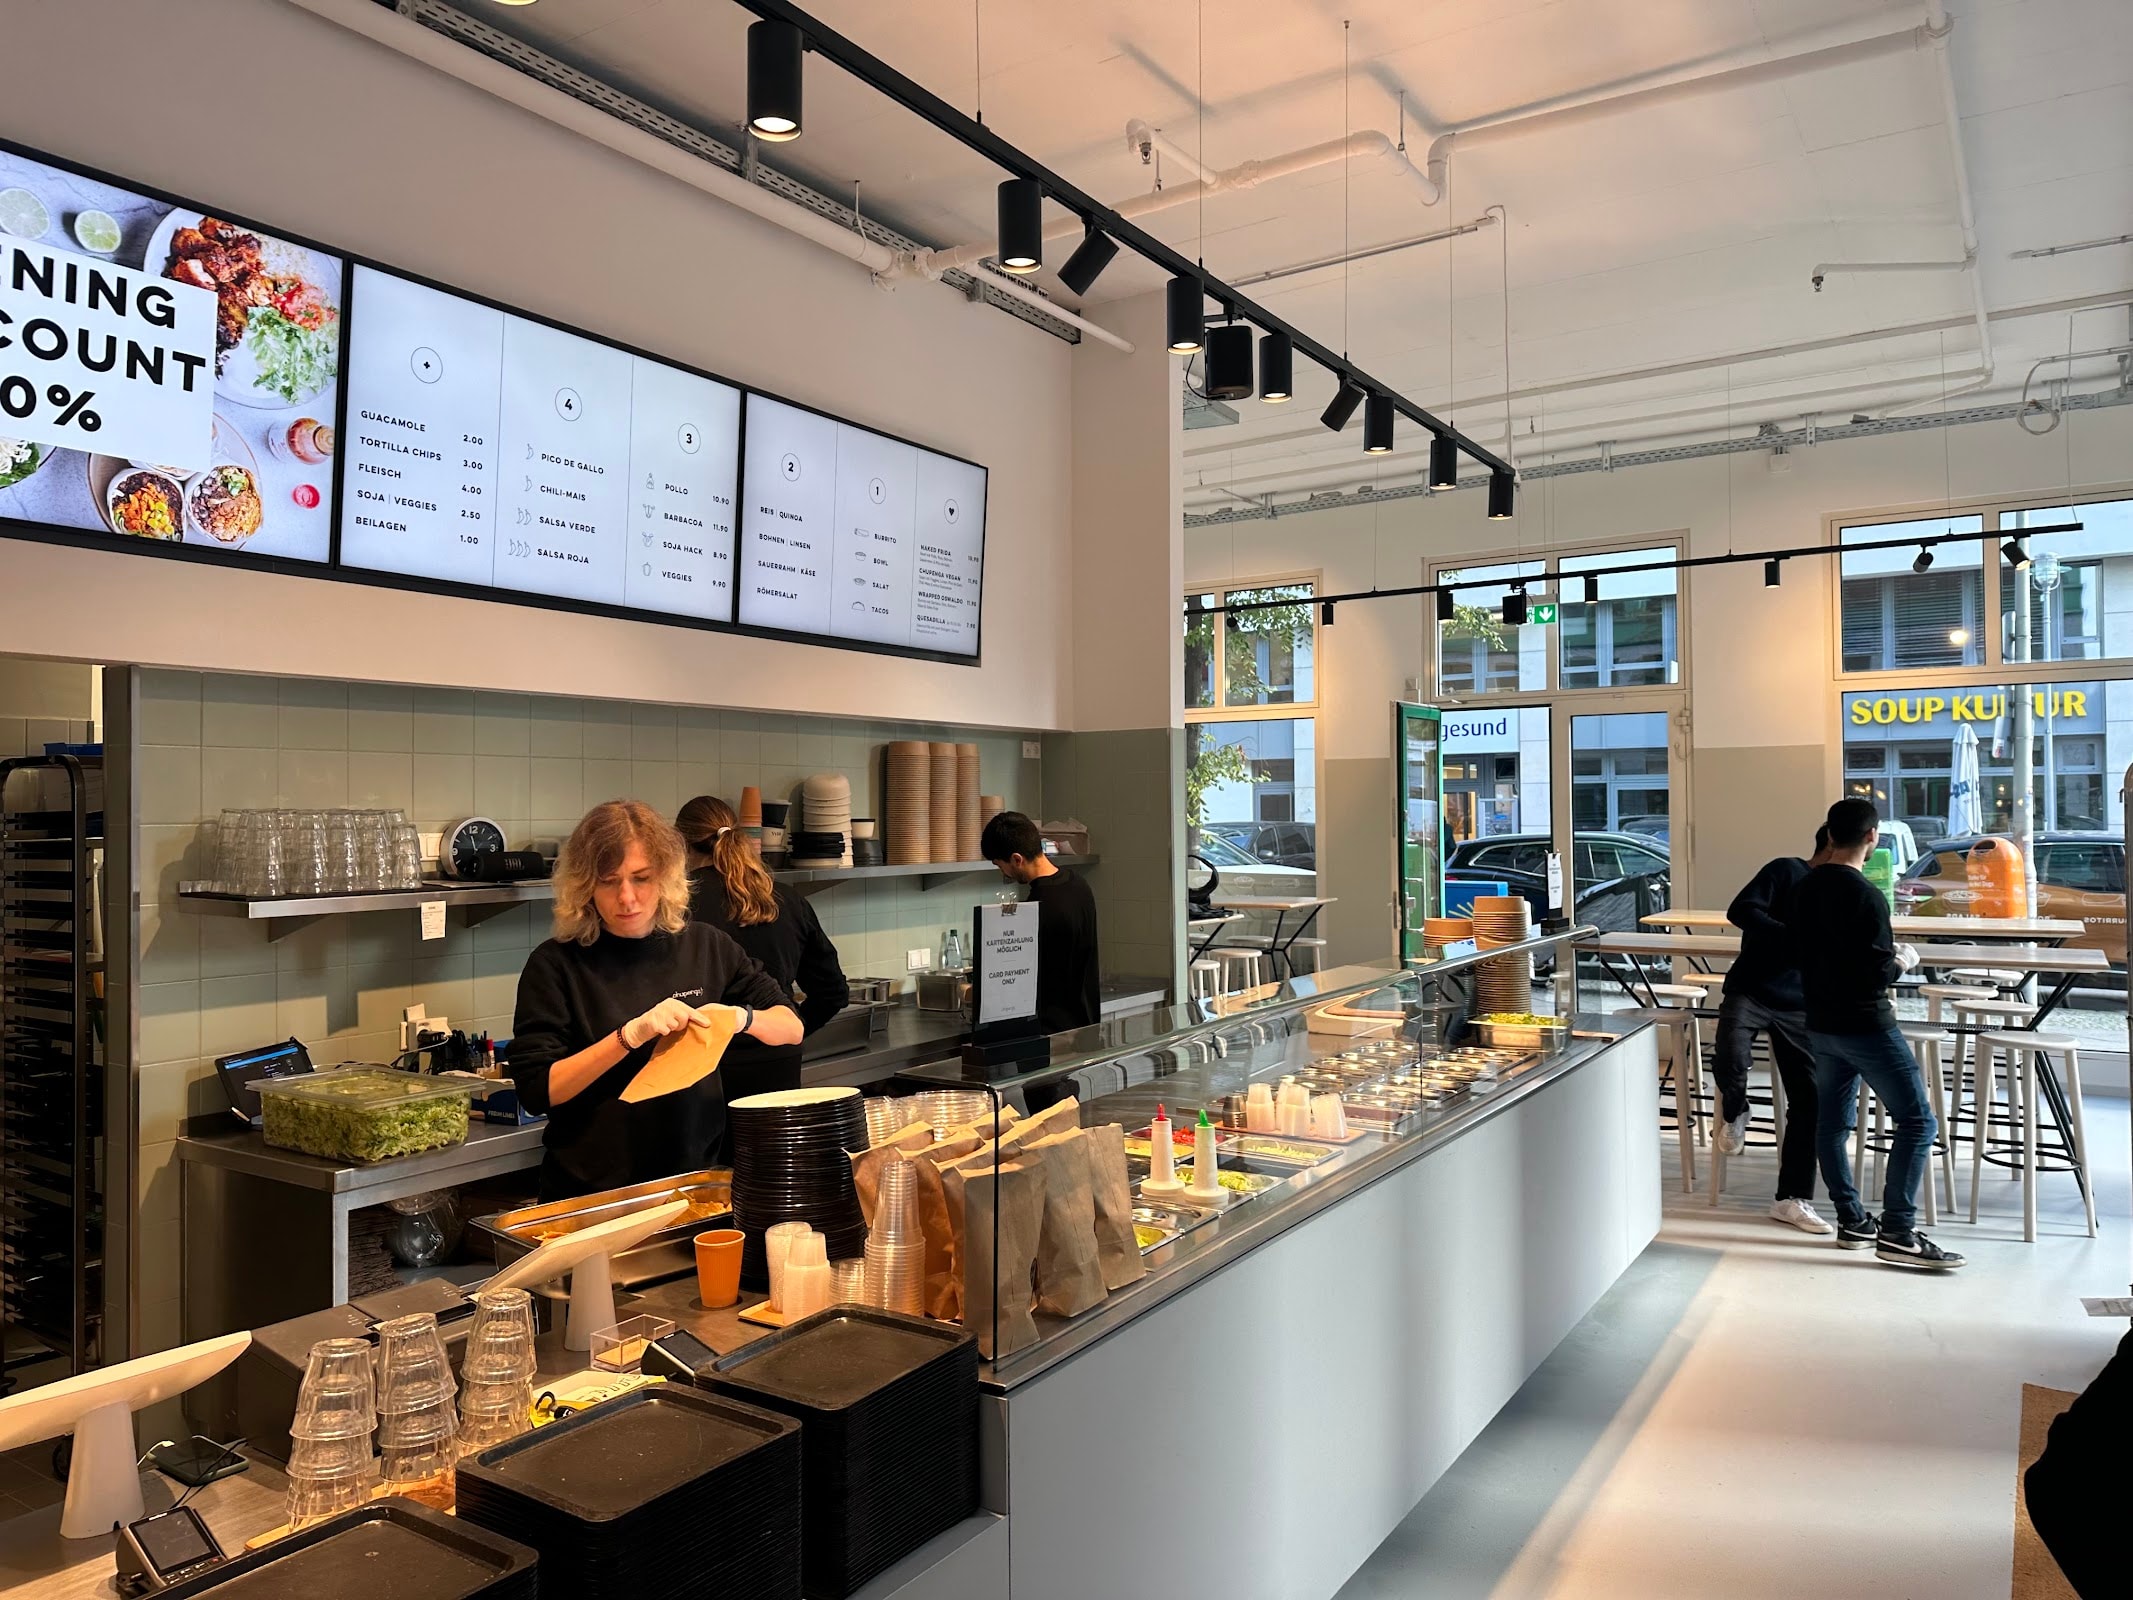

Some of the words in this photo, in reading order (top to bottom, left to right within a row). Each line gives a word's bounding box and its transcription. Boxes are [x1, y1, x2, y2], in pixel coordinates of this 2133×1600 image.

[0, 245, 176, 329] NING
[564, 398, 573, 411] 4
[361, 410, 426, 432] GUACAMOLE
[463, 434, 483, 445] 2.00
[686, 433, 693, 444] 3
[360, 436, 410, 454] TORTILLA
[412, 448, 441, 461] CHIPS
[463, 459, 483, 470] 3.00
[541, 453, 562, 465] PICO
[564, 459, 575, 468] DE
[577, 462, 604, 475] GALLO
[788, 462, 794, 472] 2
[358, 463, 401, 479] FLEISCH
[461, 484, 482, 495] 4.00
[540, 485, 587, 502] CHILI-MAIS
[665, 483, 688, 495] POLLO
[712, 495, 730, 506] 10.90
[875, 486, 880, 496] 1
[357, 489, 385, 502] SOJA
[394, 496, 437, 512] VEGGIES
[461, 510, 481, 520] 2.50
[760, 506, 774, 516] REIS
[779, 511, 803, 522] QUINOA
[355, 516, 407, 532] BEILAGEN
[460, 534, 479, 545] 1.00
[539, 516, 566, 528] SALSA
[569, 522, 596, 534] VERDE
[664, 512, 703, 528] BARBACOA
[713, 523, 729, 533] 11.90
[759, 533, 785, 545] BOHNEN
[789, 540, 811, 550] LINSEN
[874, 533, 897, 544] BURRITO
[537, 548, 565, 560] SALSA
[567, 553, 590, 565] ROJA
[663, 541, 682, 551] SOJA
[683, 545, 703, 556] HACK
[713, 551, 728, 561] 8.90
[937, 548, 951, 556] FRIDA
[758, 560, 796, 573] SAUERRAHM
[800, 567, 816, 577] KÄSE
[873, 557, 889, 566] BOWL
[662, 570, 692, 582] VEGGIES
[712, 580, 727, 589] 9.90
[872, 582, 889, 591] SALAT
[757, 587, 798, 600] RÖMERSALAT
[918, 591, 940, 600] WRAPPED
[871, 606, 889, 615] TACOS
[916, 614, 946, 625] QUESADILLA
[1851, 697, 1945, 725] SOUP
[469, 825, 478, 834] 12
[1002, 929, 1015, 937] NUR
[986, 936, 1034, 947] KARTENZAHLUNG
[996, 945, 1022, 954] MÖGLICH
[988, 970, 1004, 979] CARD
[1004, 968, 1030, 977] PAYMENT
